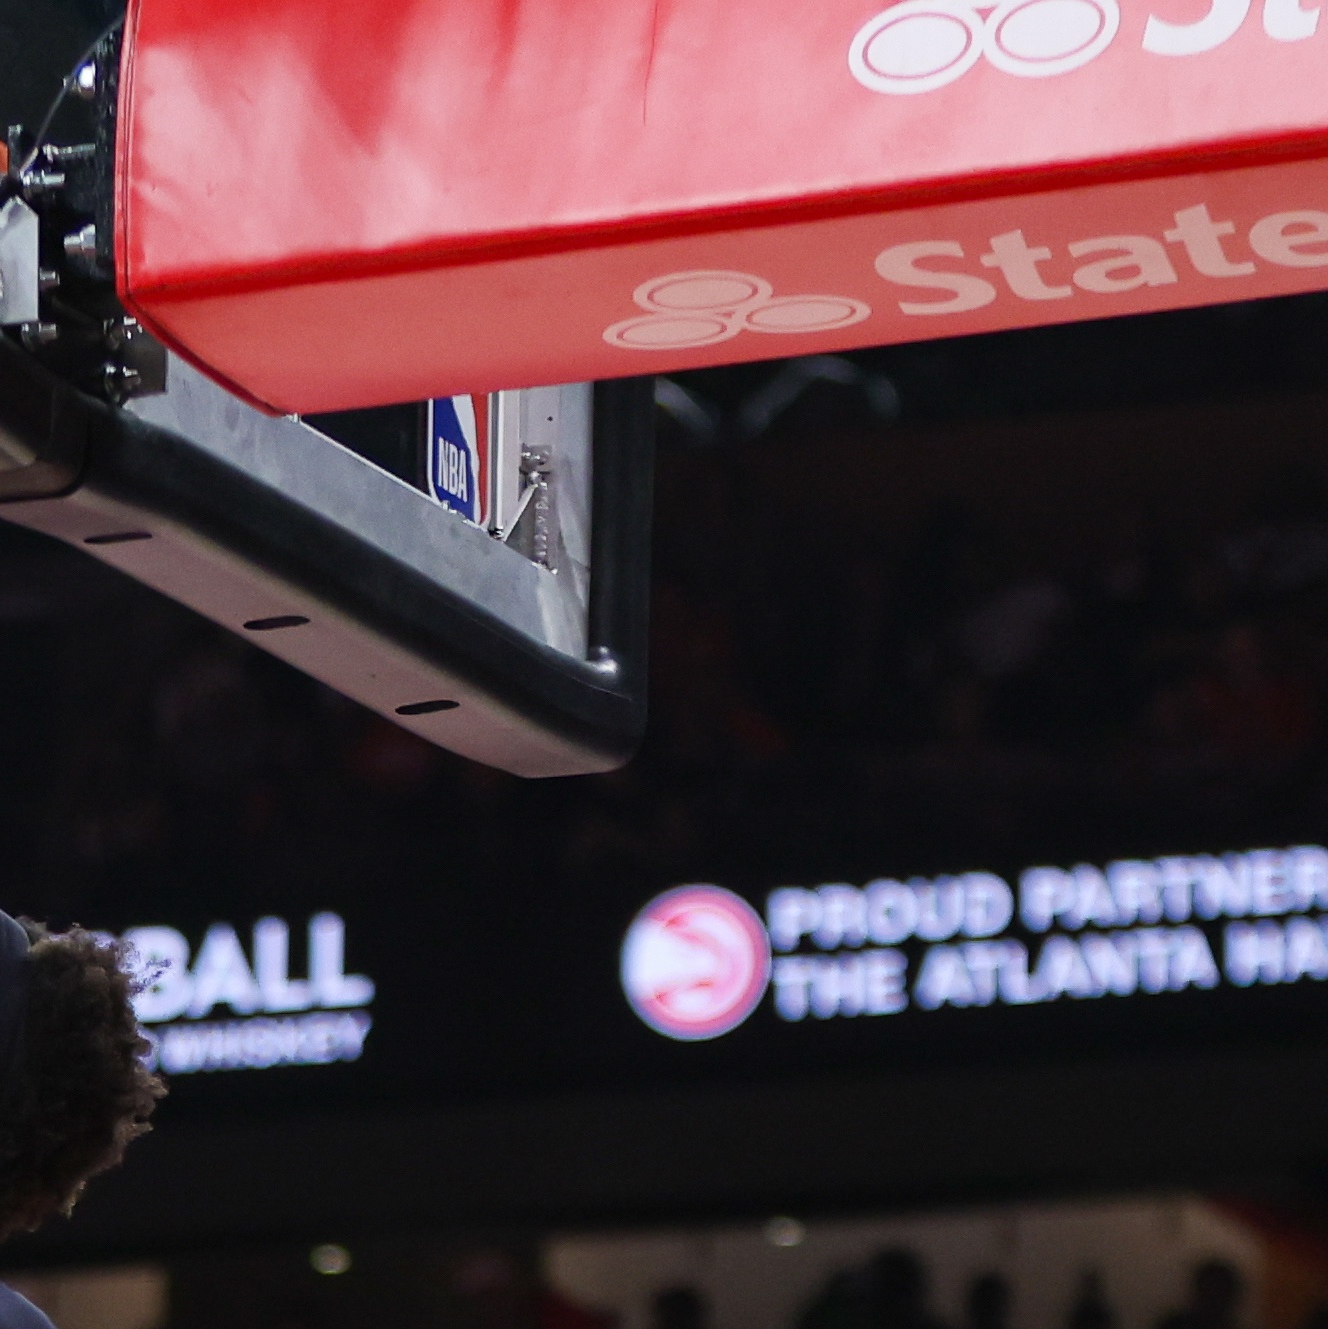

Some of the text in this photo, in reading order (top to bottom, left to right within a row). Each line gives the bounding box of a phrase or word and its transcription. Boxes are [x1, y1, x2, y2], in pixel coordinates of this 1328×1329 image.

[873, 203, 1328, 315] State
[437, 436, 467, 503] NBA
[766, 871, 1014, 953] PROUD
[95, 911, 376, 1023] BALL
[772, 914, 1328, 1022] THE ATLANTA HA
